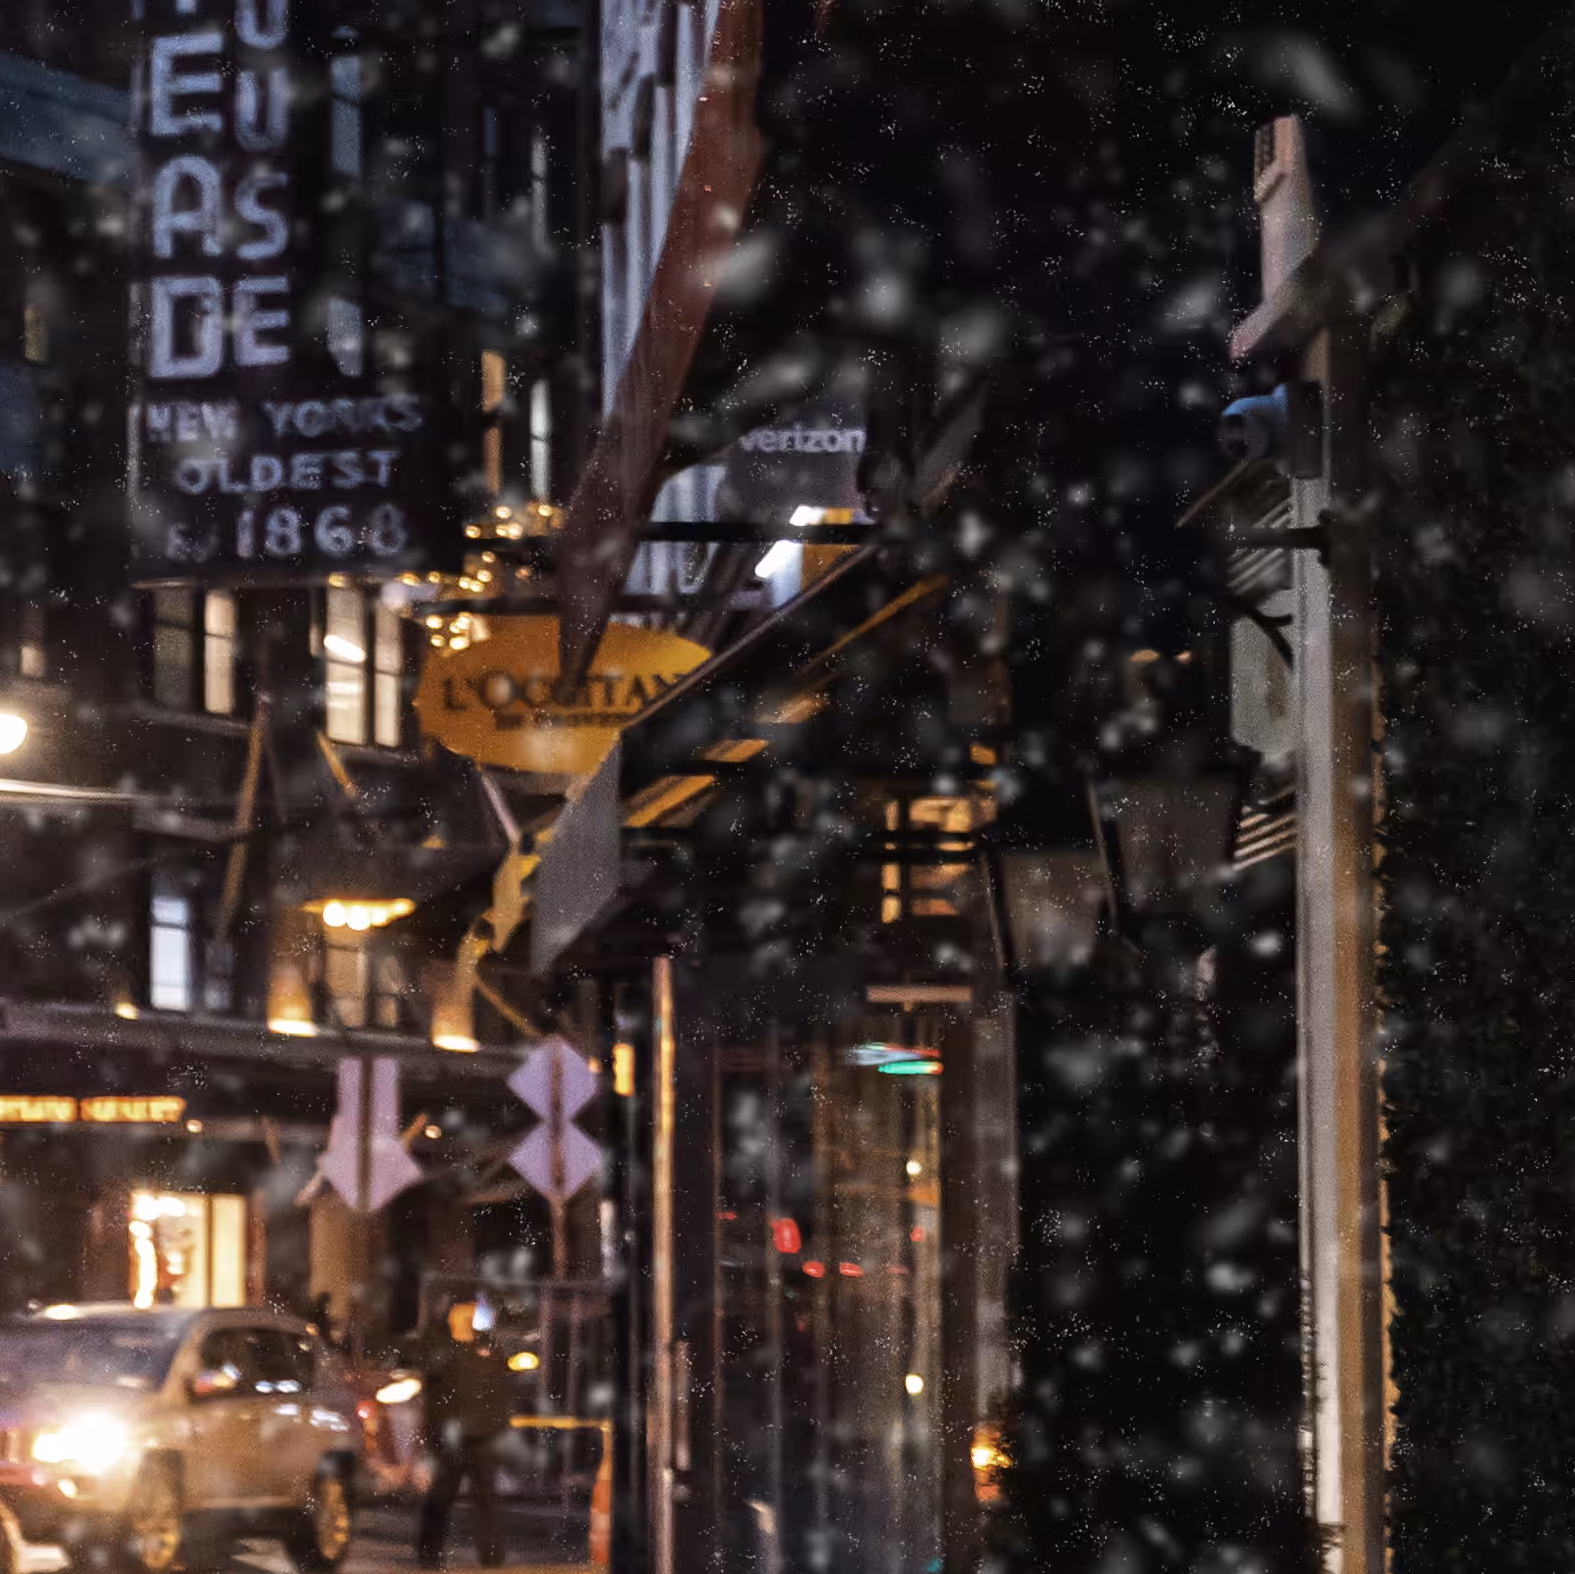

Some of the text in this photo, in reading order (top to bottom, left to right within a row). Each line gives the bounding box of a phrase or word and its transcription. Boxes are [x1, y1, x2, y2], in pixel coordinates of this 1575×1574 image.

[147, 400, 238, 442] NEW
[739, 421, 867, 454] verizon
[175, 448, 399, 494] OLDEST
[236, 504, 407, 558] 1868
